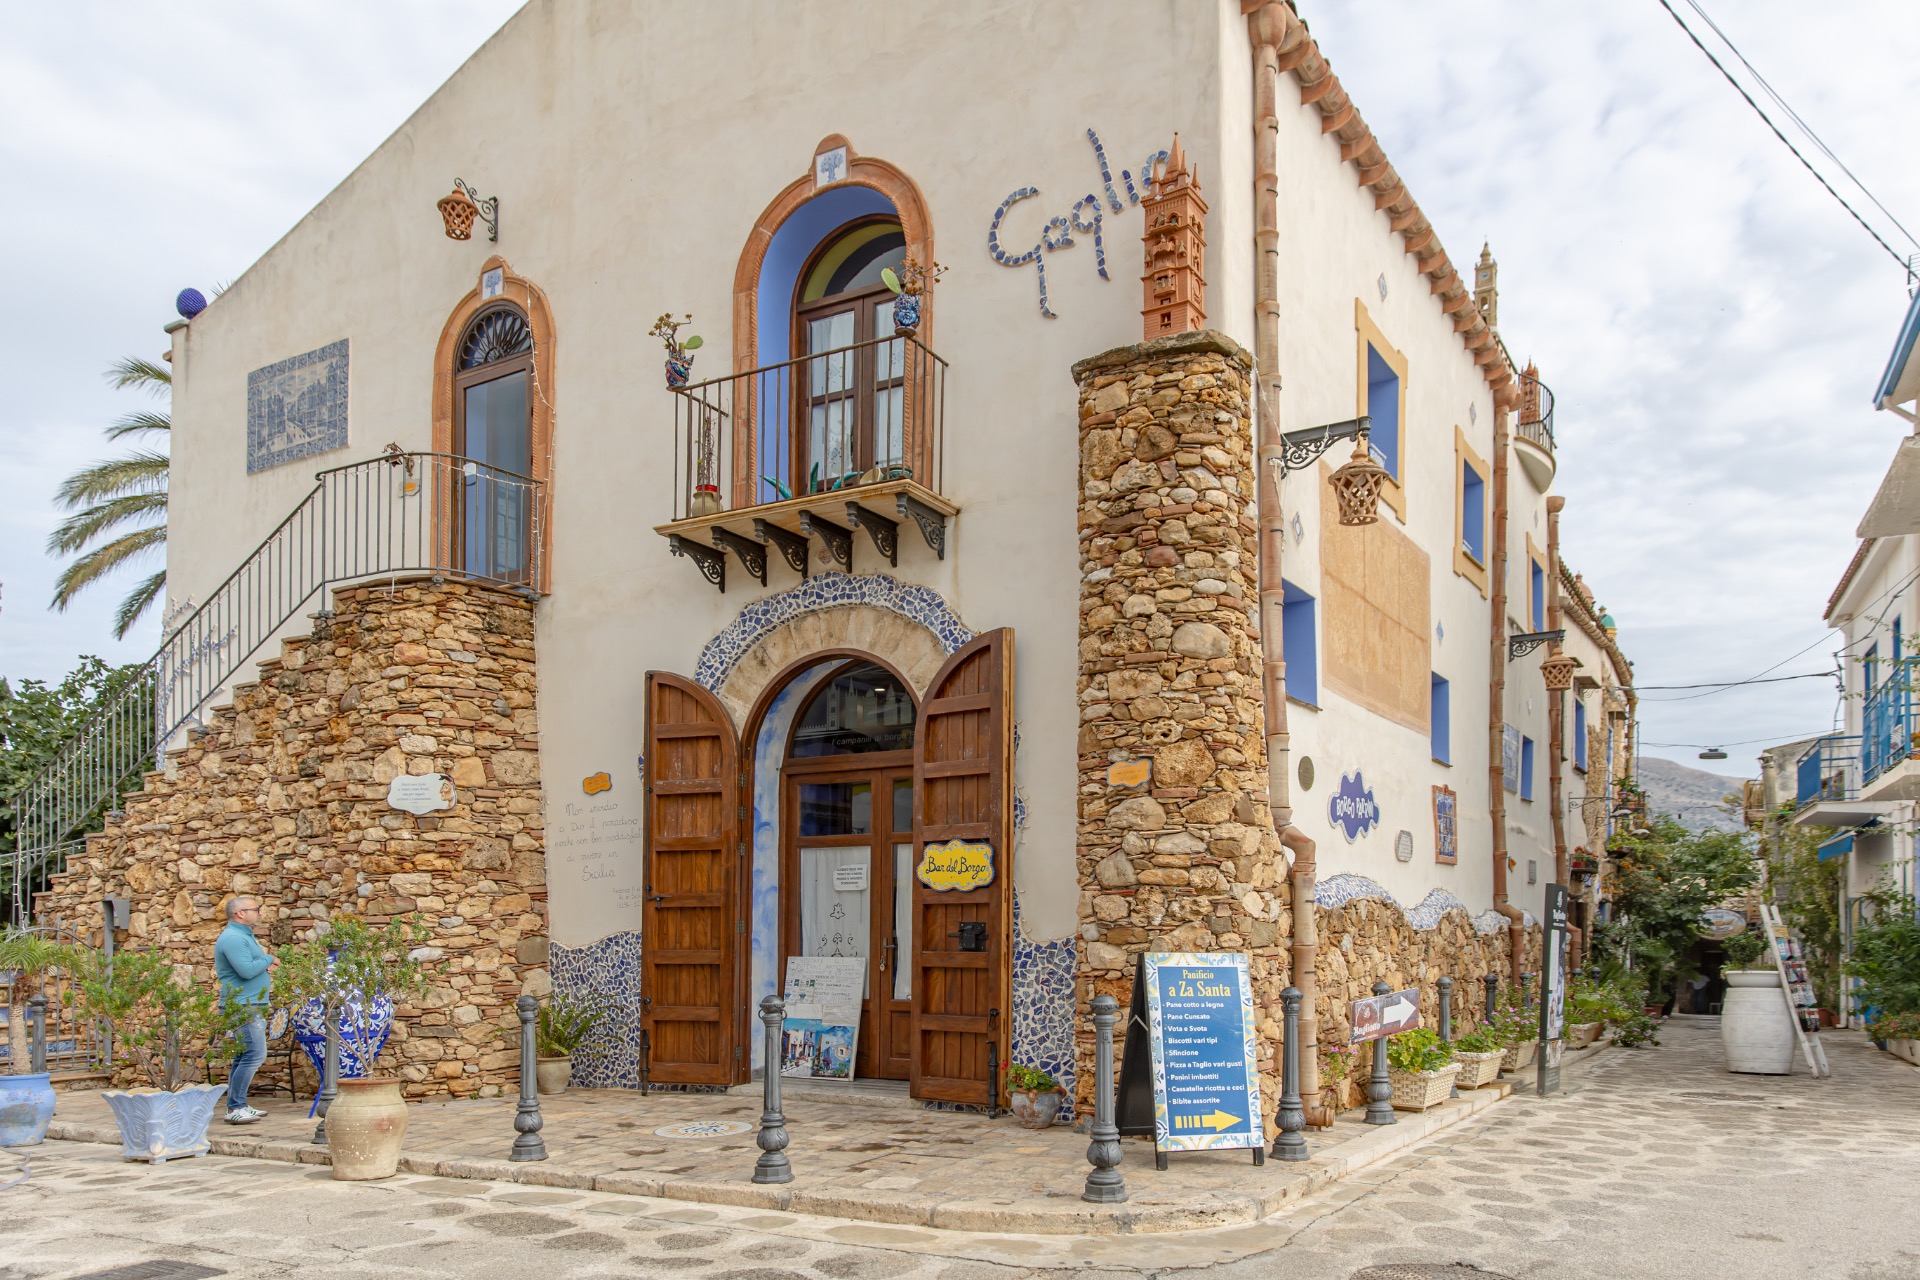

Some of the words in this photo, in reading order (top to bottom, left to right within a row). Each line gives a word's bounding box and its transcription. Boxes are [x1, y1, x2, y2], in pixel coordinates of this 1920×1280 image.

[837, 736, 872, 745] campanili
[566, 803, 583, 816] Non
[1336, 796, 1354, 818] BORGO
[602, 816, 638, 830] paradiso
[582, 864, 616, 881] Sicilia
[926, 856, 944, 874] Bar
[946, 858, 957, 872] del
[958, 857, 986, 879] Borgo
[1183, 970, 1214, 979] Panificio
[1169, 986, 1176, 996] a
[1179, 981, 1194, 996] Za
[1197, 981, 1231, 996] Santa
